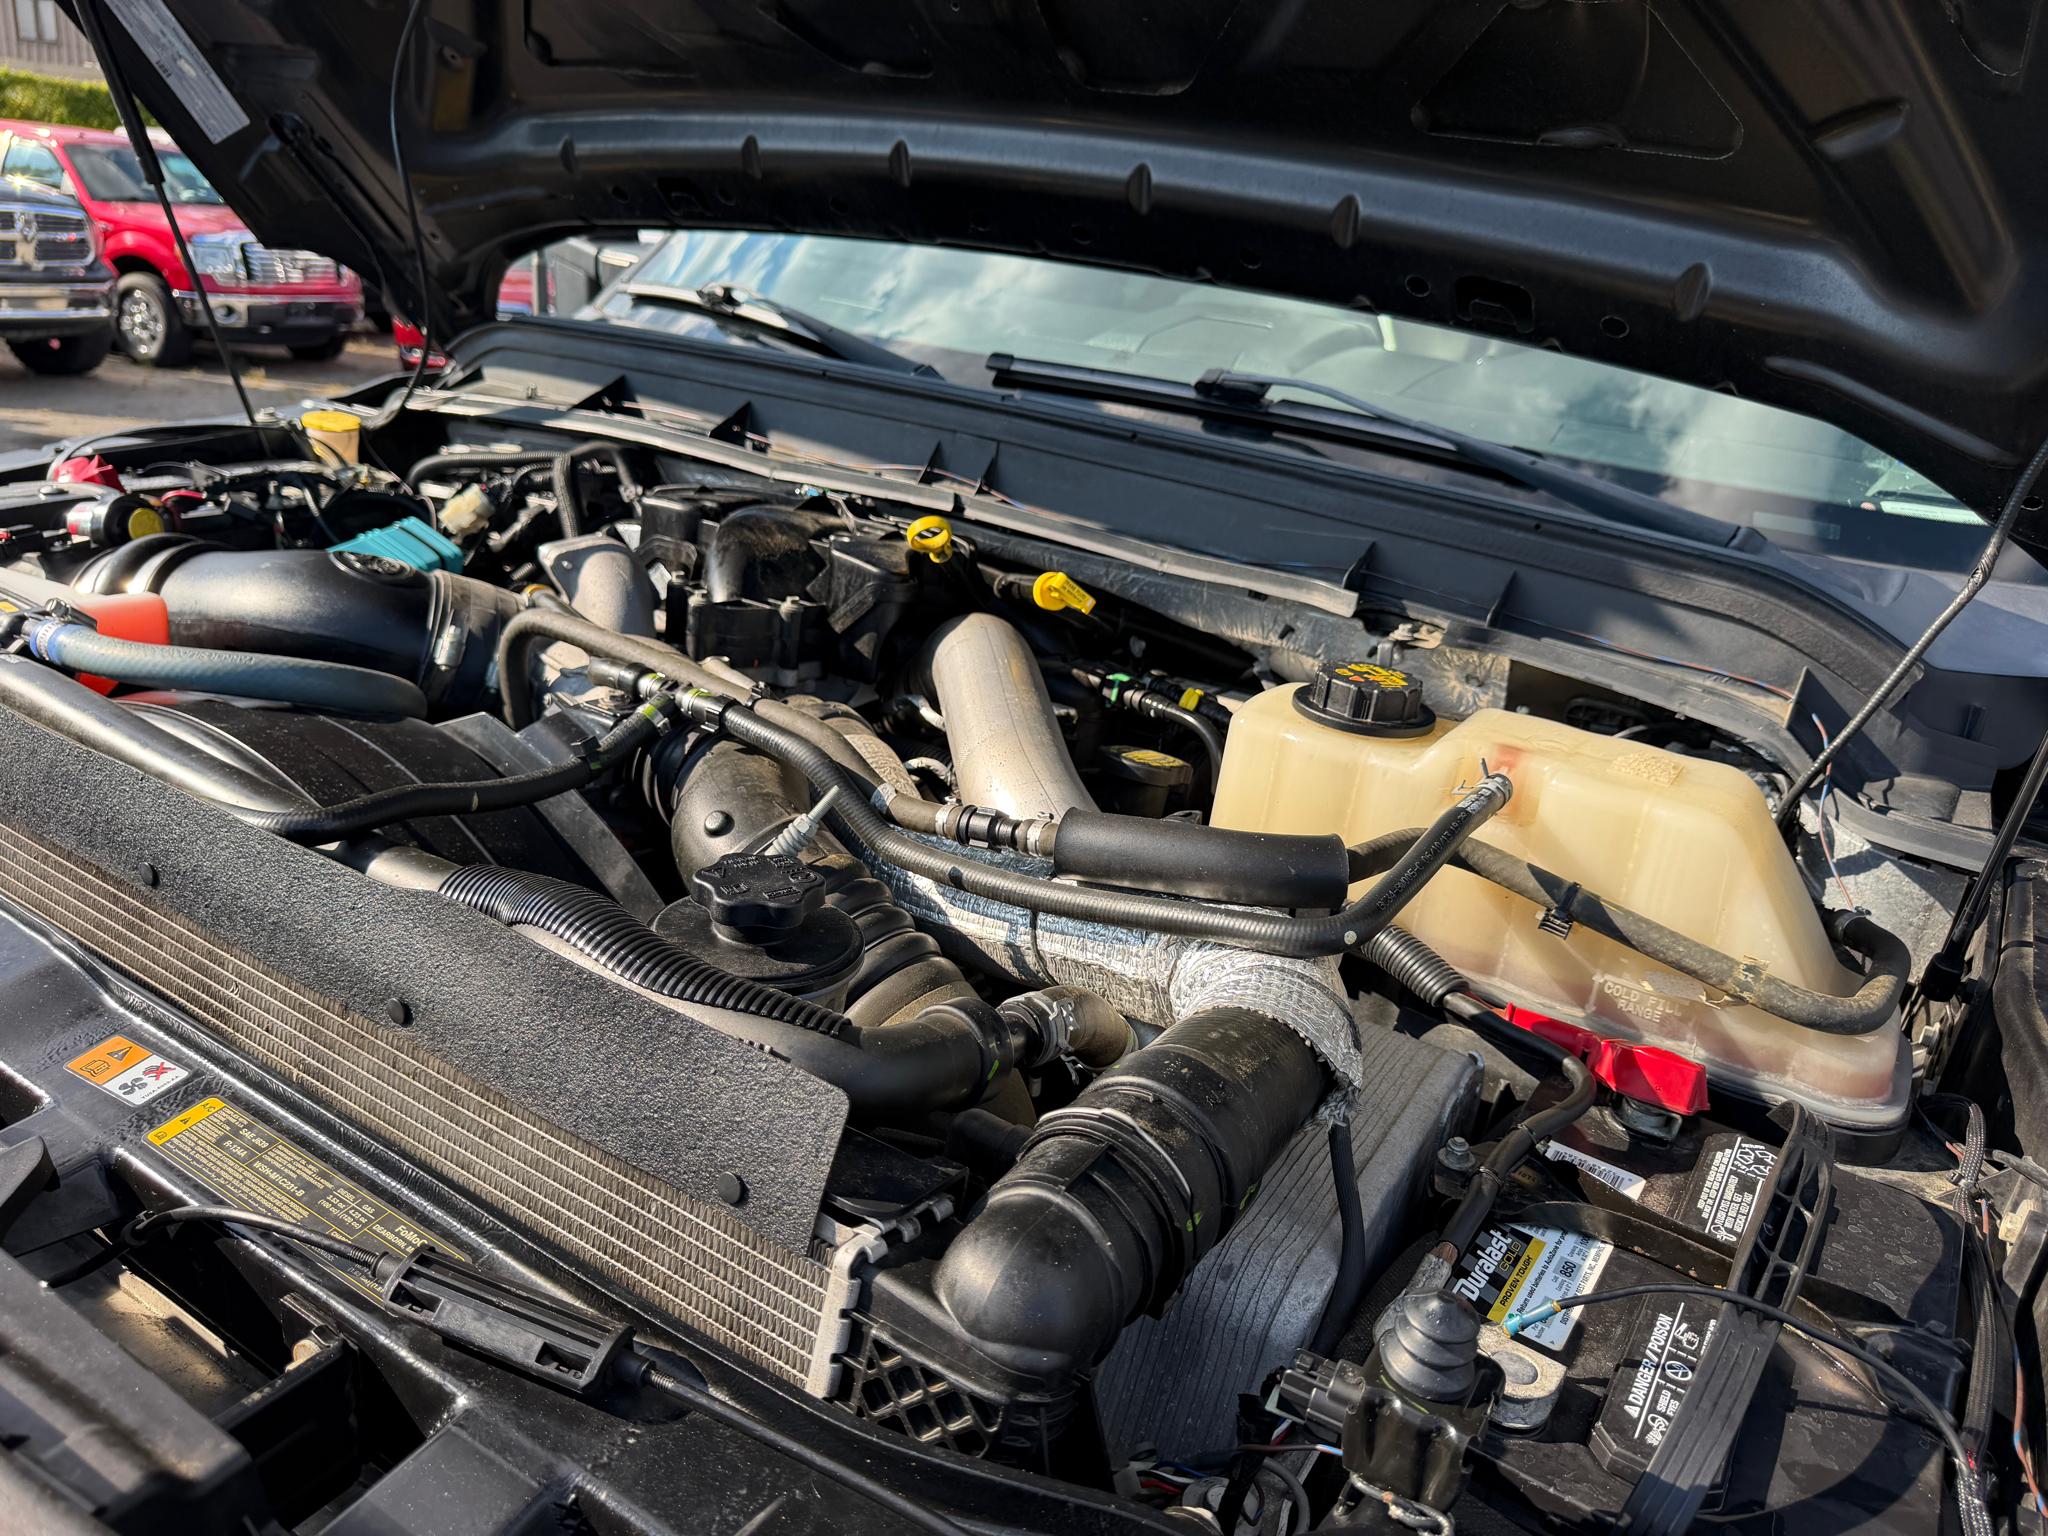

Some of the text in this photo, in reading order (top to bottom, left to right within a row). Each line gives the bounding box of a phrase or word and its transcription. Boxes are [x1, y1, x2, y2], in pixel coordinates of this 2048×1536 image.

[1604, 981, 1682, 1017] COLD FILL
[1617, 999, 1662, 1022] RANGE
[201, 1102, 216, 1112] A/C
[223, 1140, 248, 1158] R-134A
[239, 1128, 255, 1142] SAE
[252, 1136, 269, 1149] J639
[252, 1161, 305, 1197] WSH-M1C231-B
[337, 1187, 376, 1214] DIESEL GAS
[1739, 1202, 1749, 1215] HELP
[373, 1224, 407, 1250] DEARBORN,
[395, 1224, 428, 1247] FoMoC
[1452, 1229, 1513, 1302] Duralast
[1499, 1241, 1522, 1271] GOLD
[1500, 1279, 1521, 1307] PROVEN
[1516, 1255, 1533, 1278] TOUGH
[1517, 1297, 1530, 1314] Return
[1528, 1288, 1537, 1300] used
[1533, 1269, 1546, 1288] batteries
[1546, 1245, 1560, 1266] AutoZone
[1560, 1261, 1577, 1278] 850
[1657, 1390, 1671, 1412] SHIELD
[1667, 1399, 1680, 1416] EYES
